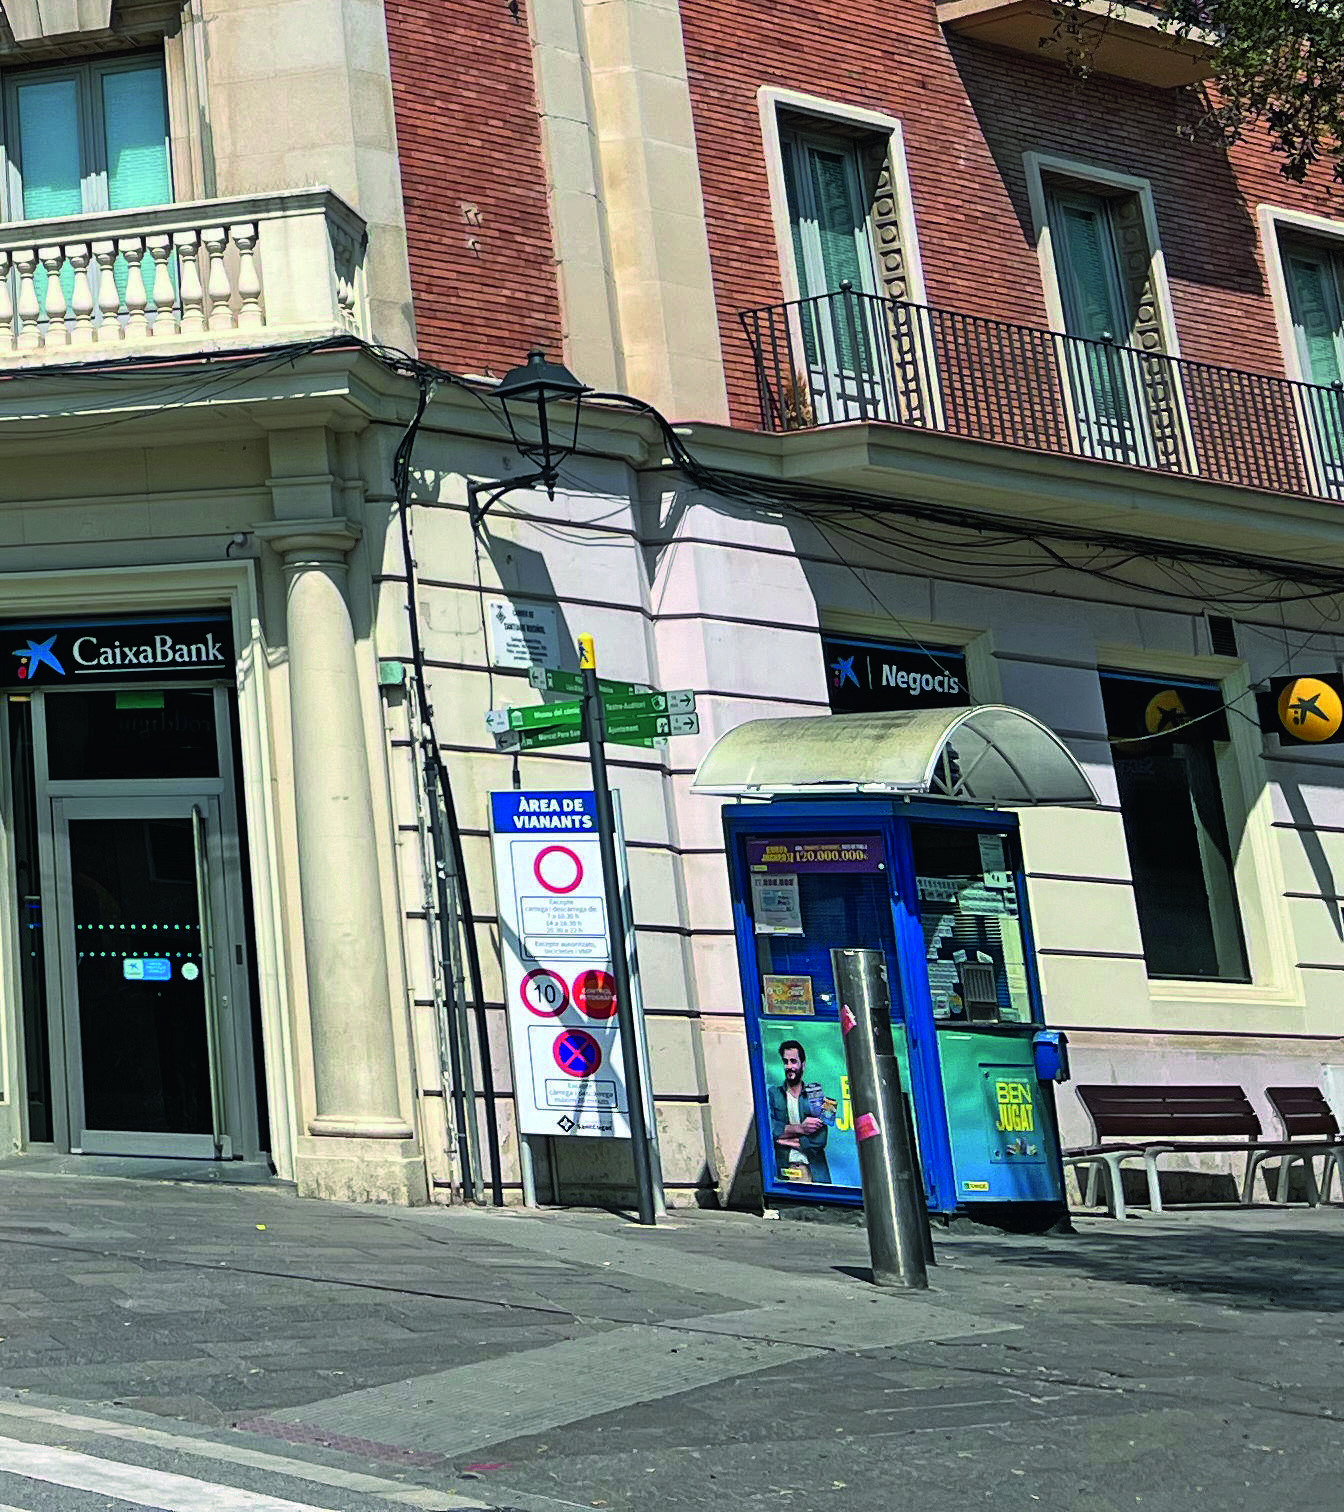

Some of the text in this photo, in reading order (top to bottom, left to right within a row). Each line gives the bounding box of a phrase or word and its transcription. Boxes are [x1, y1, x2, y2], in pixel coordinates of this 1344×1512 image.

[72, 632, 225, 666] CaixaBank
[881, 663, 960, 695] Negocis
[518, 796, 584, 813] ÀREA DE
[512, 815, 593, 829] VIANANTS
[533, 983, 557, 1004] 10
[995, 1081, 1032, 1104] BEN
[995, 1103, 1034, 1132] JUGAT
